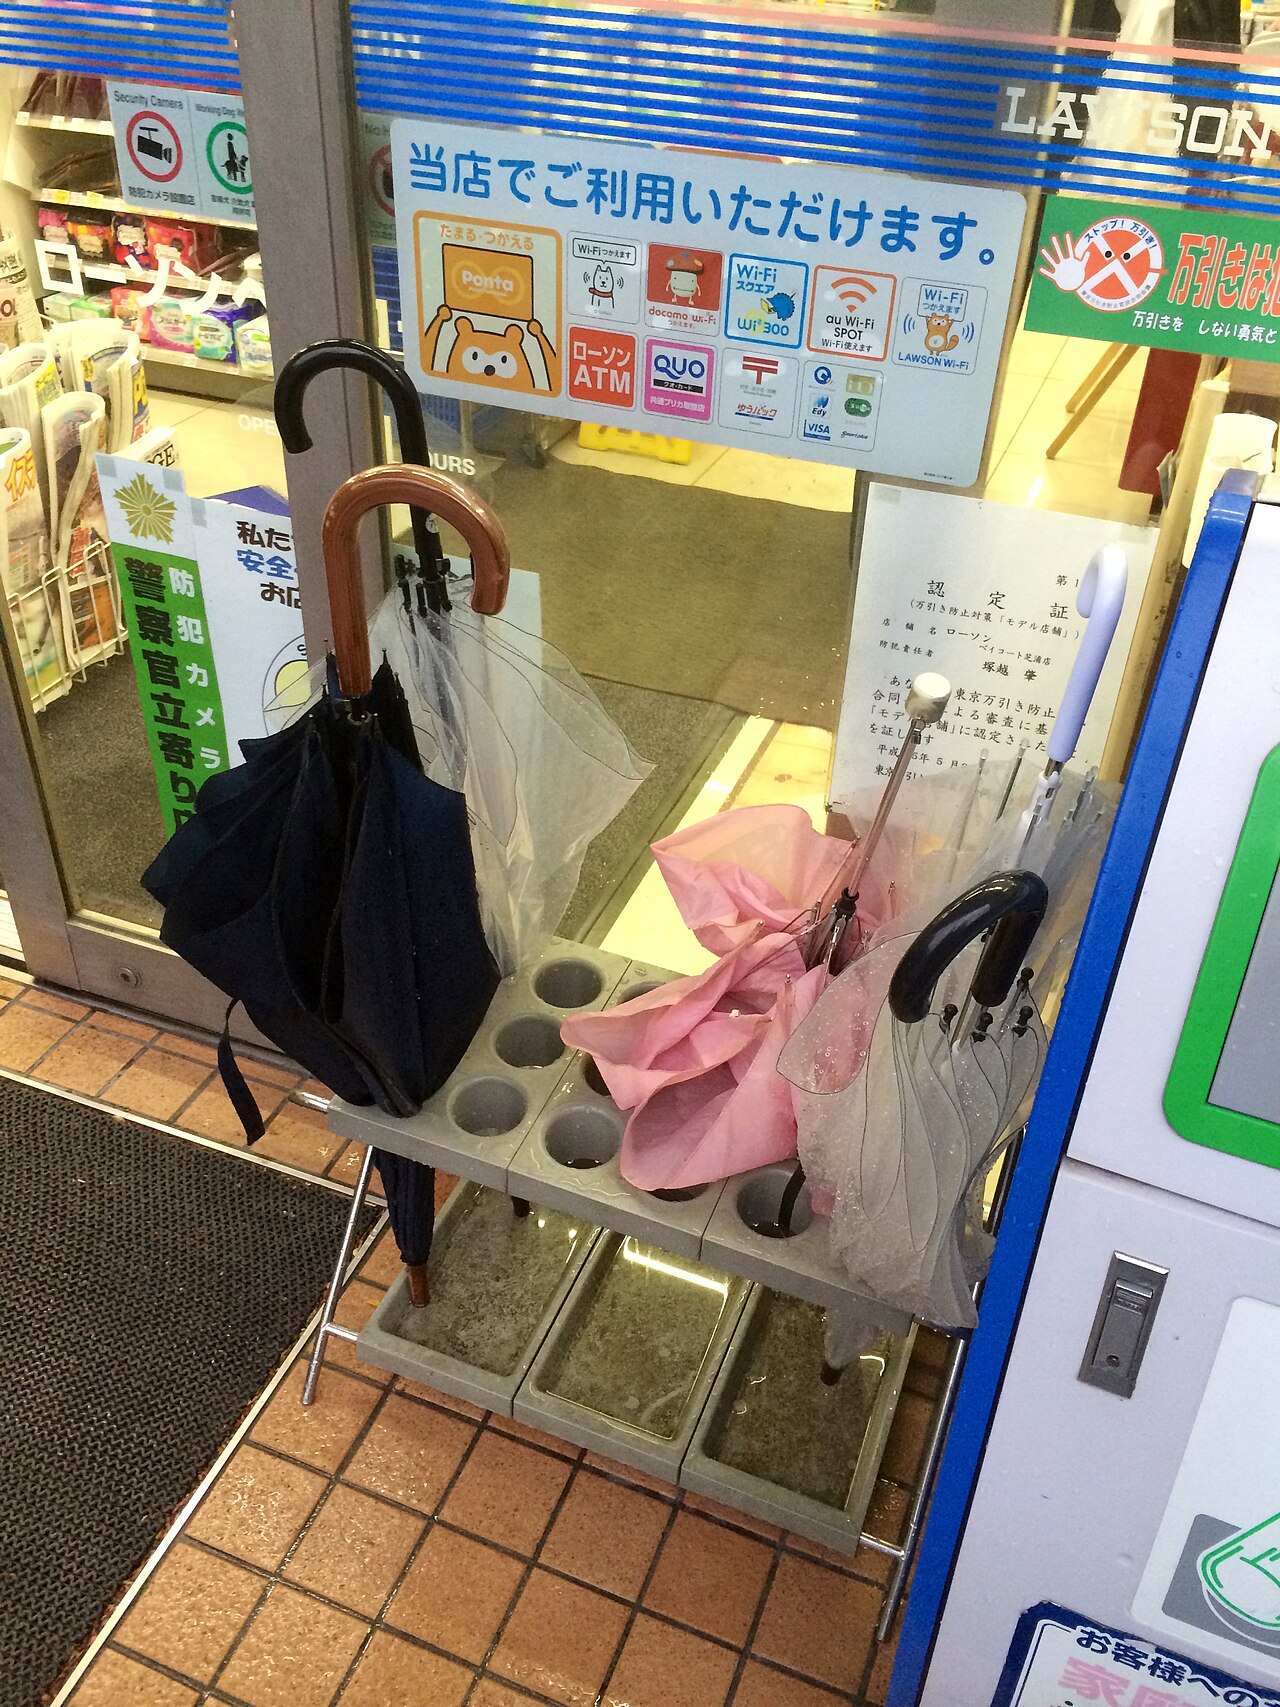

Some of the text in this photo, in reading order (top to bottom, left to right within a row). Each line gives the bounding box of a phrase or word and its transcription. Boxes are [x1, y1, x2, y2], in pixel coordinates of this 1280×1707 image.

[113, 90, 184, 110] Security Camera
[1001, 86, 1272, 159] LASON
[410, 143, 995, 265] 当店でご利用いただけます。
[462, 269, 514, 293] Ponta
[736, 263, 777, 283] Wi-Fi
[735, 281, 775, 295] スクエア
[925, 288, 965, 305] Wi-Fi
[648, 306, 688, 321] docomo
[922, 303, 961, 315] つかえます
[825, 314, 875, 330] au Wi-Fi
[1132, 310, 1278, 344] 万引きを しない勇気と
[833, 328, 864, 341] SPOT
[573, 341, 632, 367] ローソン
[898, 352, 970, 371] LAWSON Wi-Fi
[654, 354, 705, 379] QUO
[573, 364, 631, 394] ATM
[812, 408, 828, 418] Edy
[238, 413, 278, 437] OPE
[808, 423, 831, 434] VISA
[236, 520, 294, 552] 私た
[237, 549, 297, 580] 安全
[927, 579, 1069, 620] 認定証
[947, 628, 992, 643] ローソン
[168, 567, 221, 769] 防犯カメラ
[870, 723, 934, 745] を証しす
[1076, 1628, 1280, 1707] お客様への
